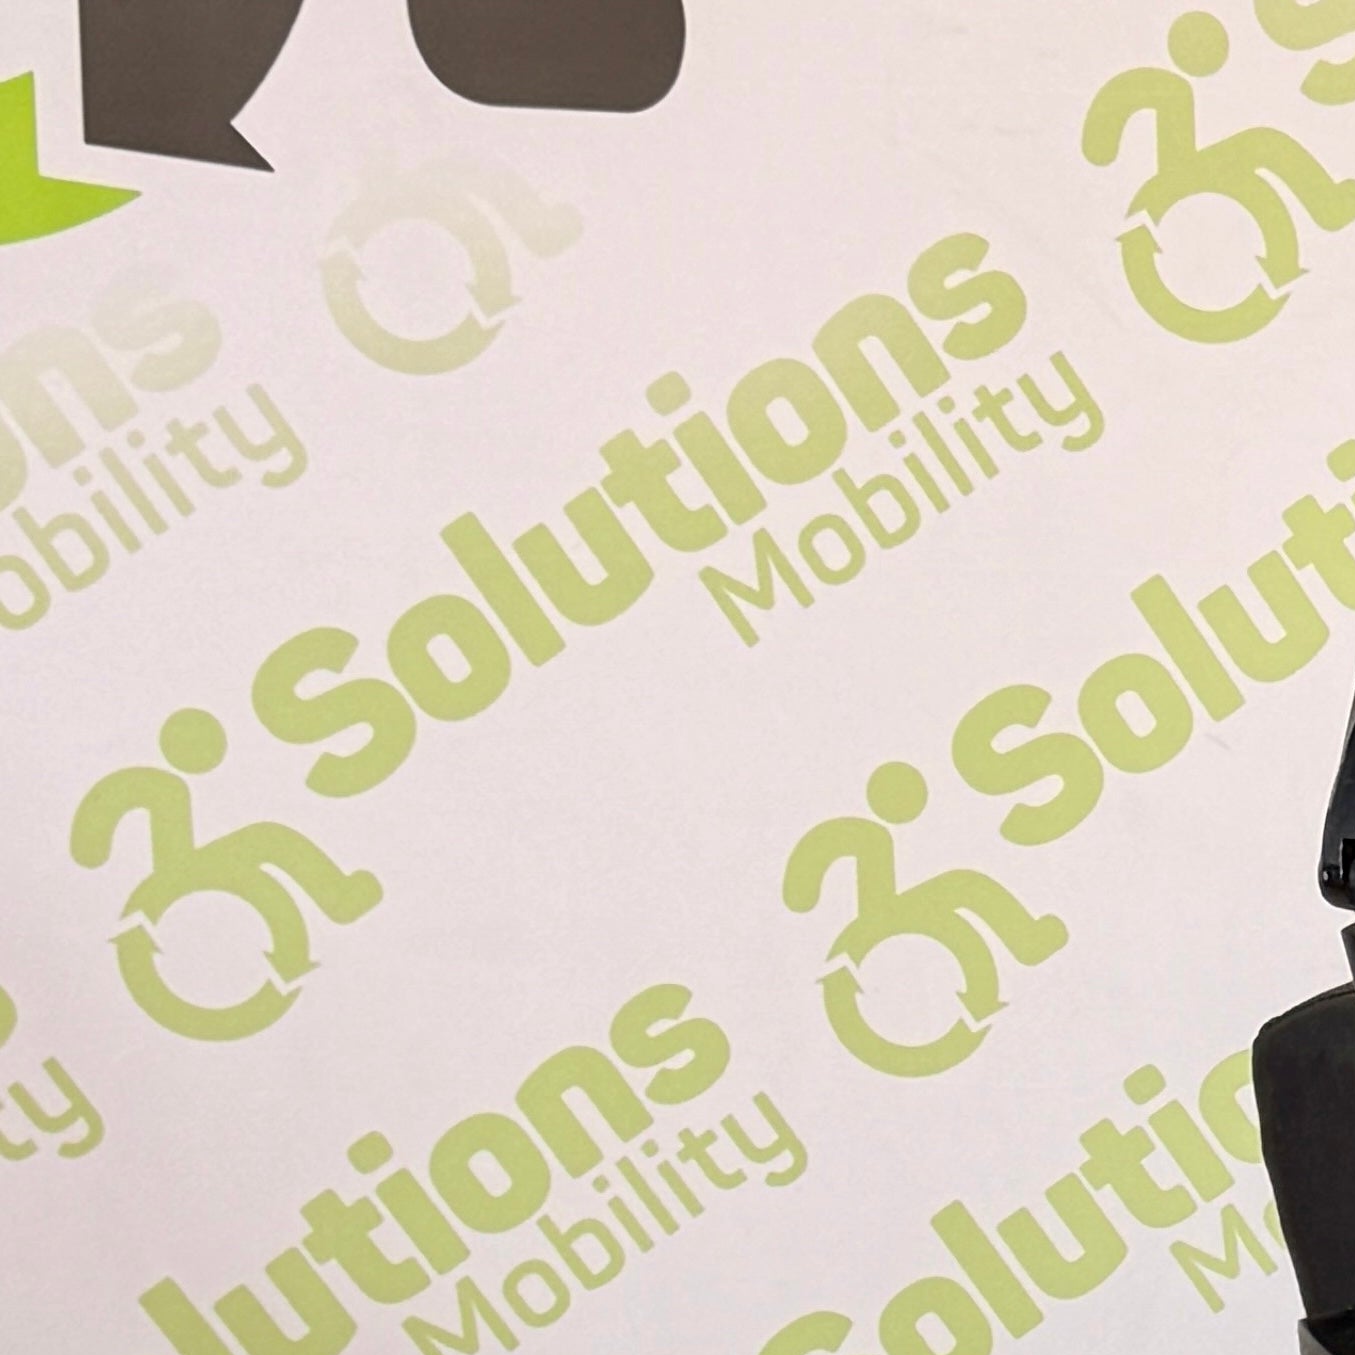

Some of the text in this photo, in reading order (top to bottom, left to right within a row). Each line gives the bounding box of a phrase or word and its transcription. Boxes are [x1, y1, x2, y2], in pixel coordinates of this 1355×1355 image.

[0, 383, 309, 631] obility
[251, 231, 1028, 798] Solutions
[697, 350, 1106, 647] Mobility
